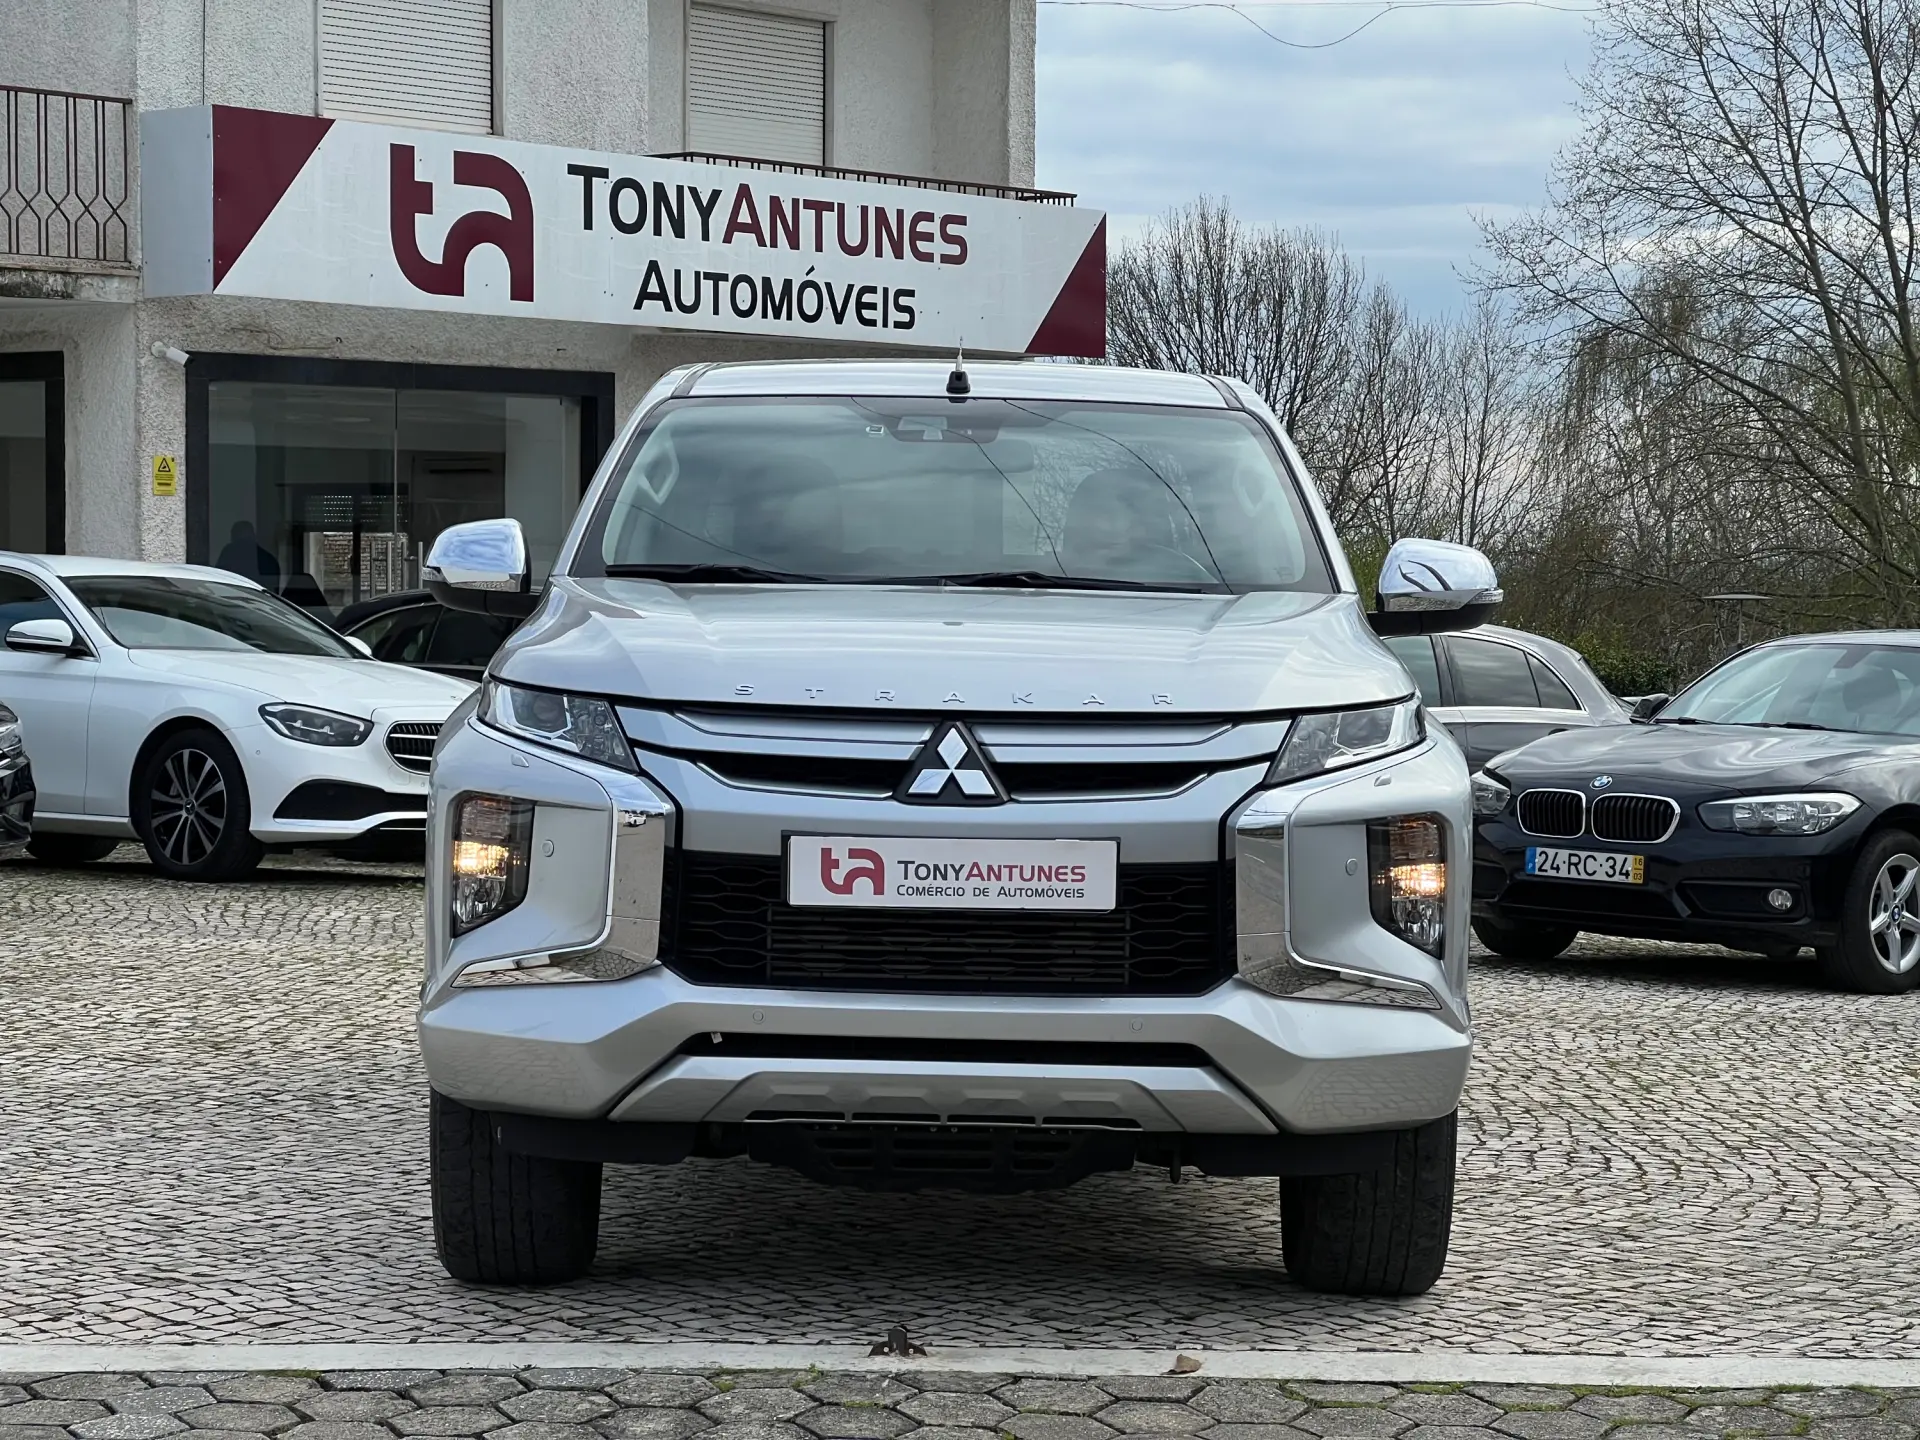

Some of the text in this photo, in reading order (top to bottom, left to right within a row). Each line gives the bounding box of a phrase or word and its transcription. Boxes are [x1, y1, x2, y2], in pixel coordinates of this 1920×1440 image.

[633, 259, 917, 331] AUTOMÓVEIS
[734, 684, 1173, 705] STRAKAR
[1633, 872, 1643, 881] 03
[896, 883, 1085, 899] COMÉRCIO DE AUTOMÓVEIS
